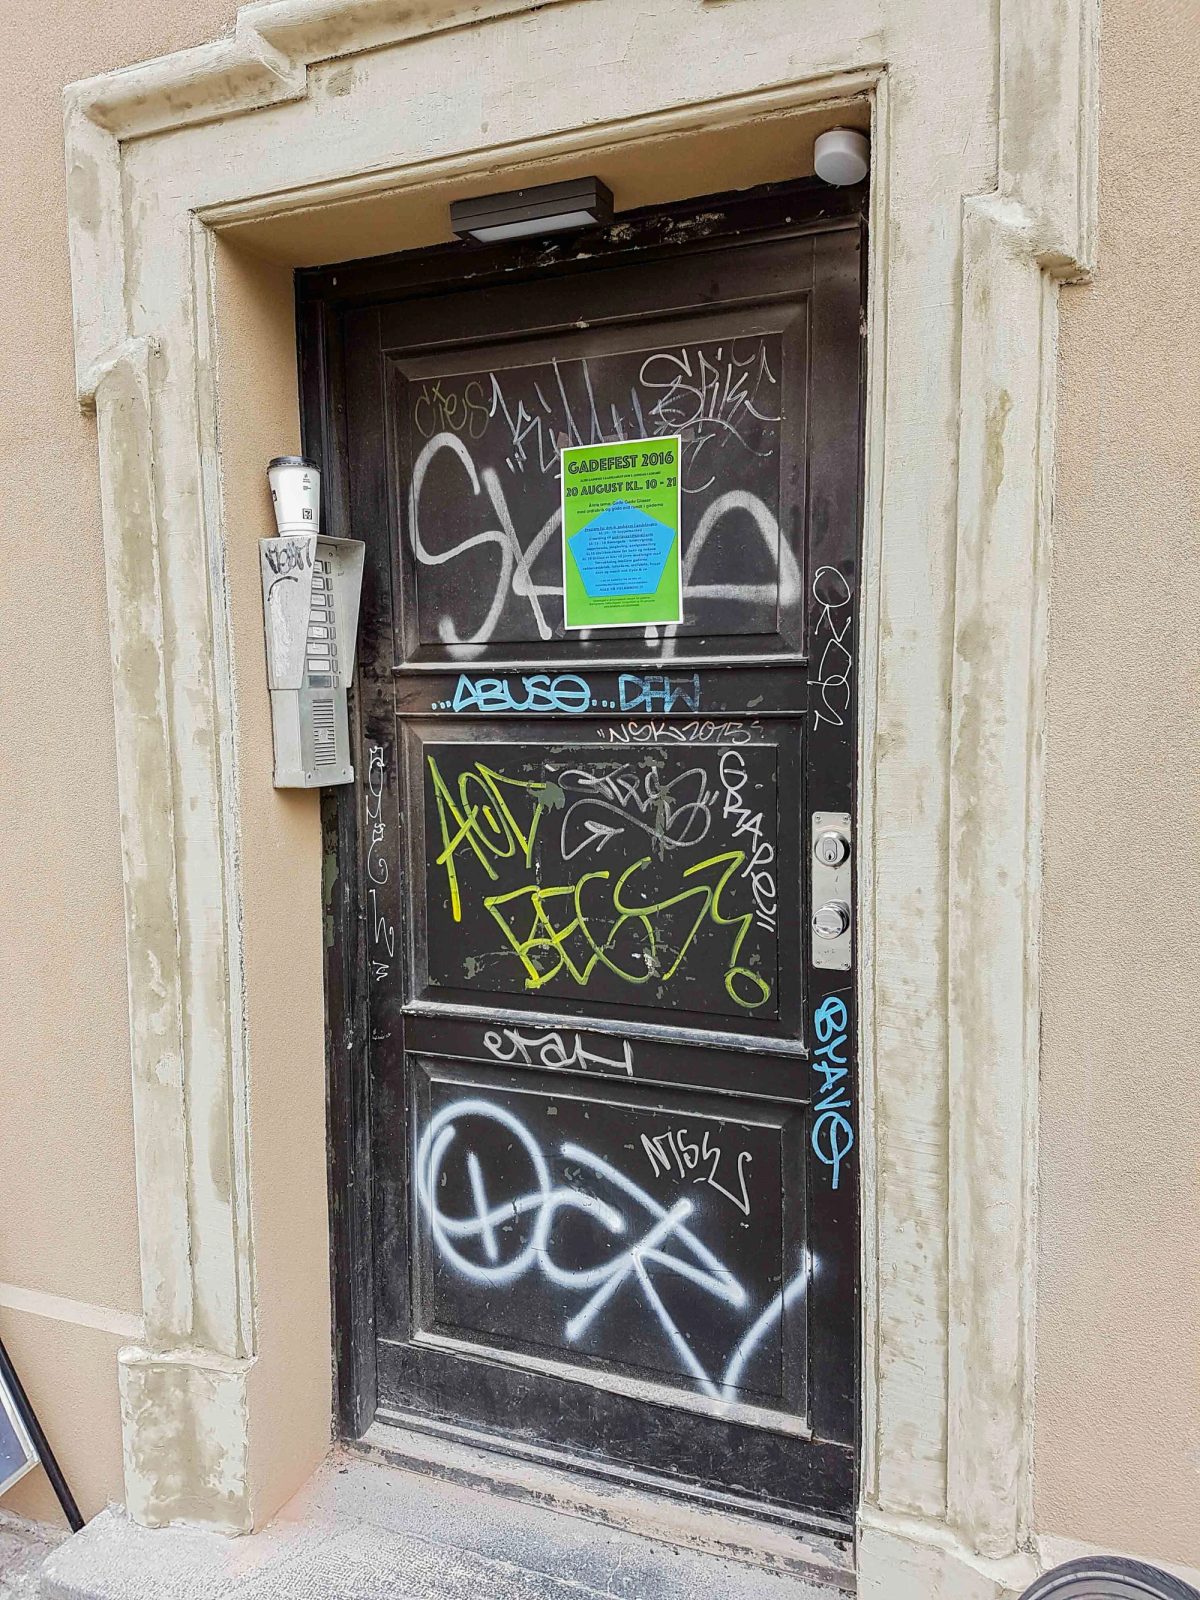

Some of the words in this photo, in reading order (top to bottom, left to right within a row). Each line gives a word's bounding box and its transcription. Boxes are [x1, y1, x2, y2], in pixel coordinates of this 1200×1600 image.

[567, 454, 638, 474] GADEFEST
[641, 450, 674, 467] 2016
[565, 486, 579, 497] 20
[580, 481, 623, 496] AUGUST
[625, 479, 643, 491] KL.
[645, 478, 657, 490] 10
[666, 476, 677, 488] 21
